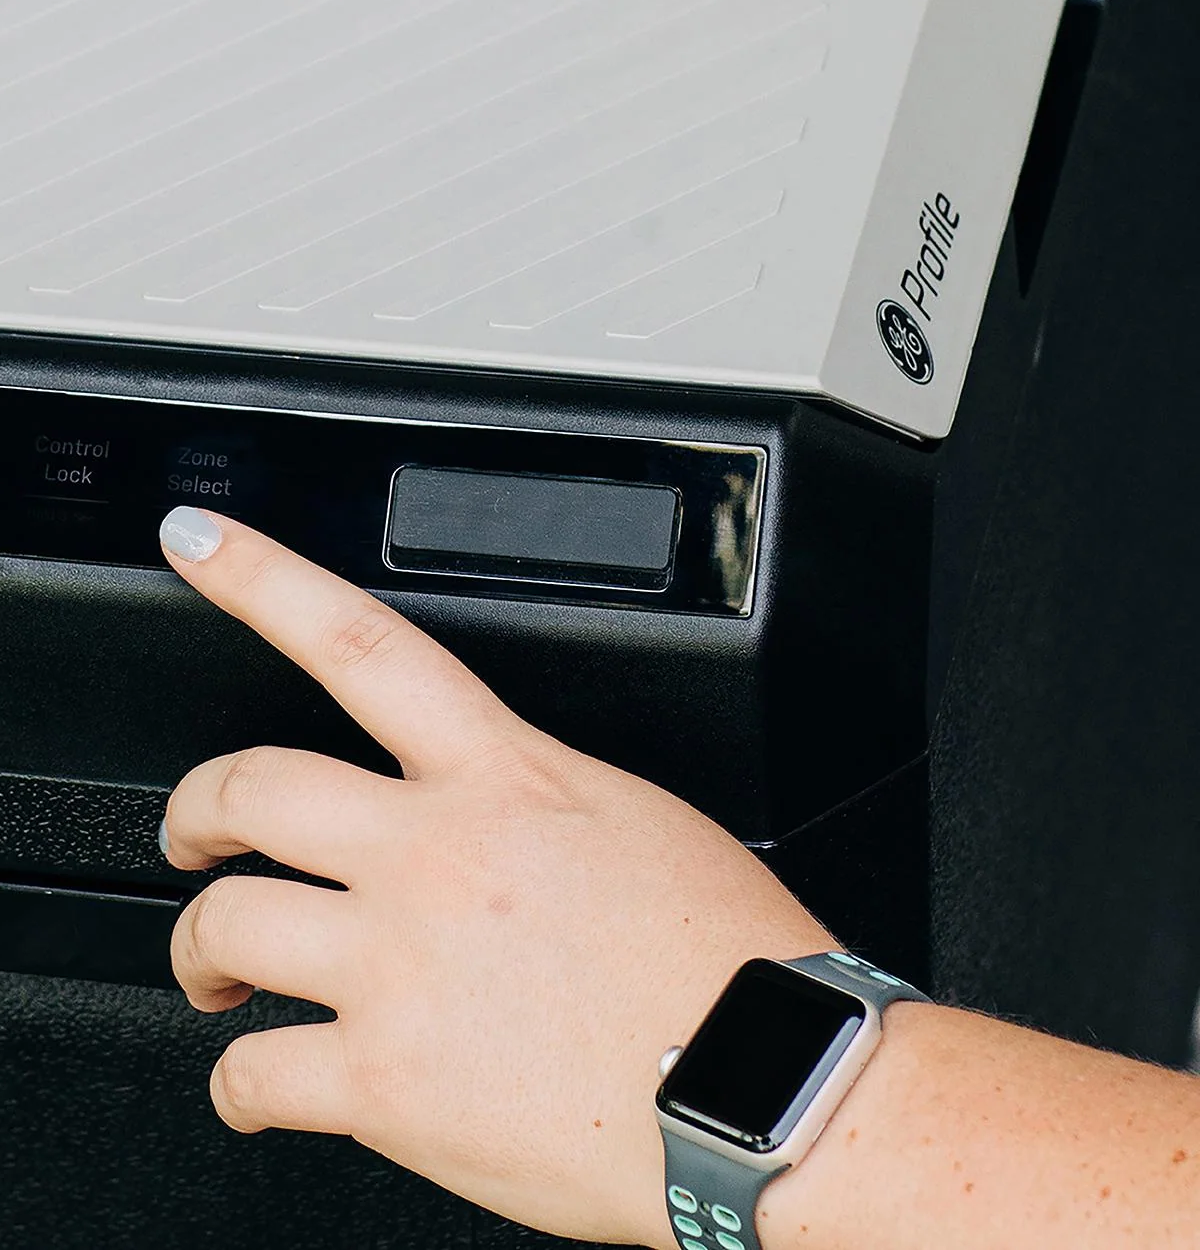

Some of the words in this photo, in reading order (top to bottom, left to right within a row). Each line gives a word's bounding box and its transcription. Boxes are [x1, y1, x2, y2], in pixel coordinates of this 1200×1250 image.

[900, 192, 960, 321] Profile
[34, 434, 111, 458] Control
[177, 446, 229, 468] Zone
[44, 463, 93, 485] Lock
[167, 474, 232, 496] Select
